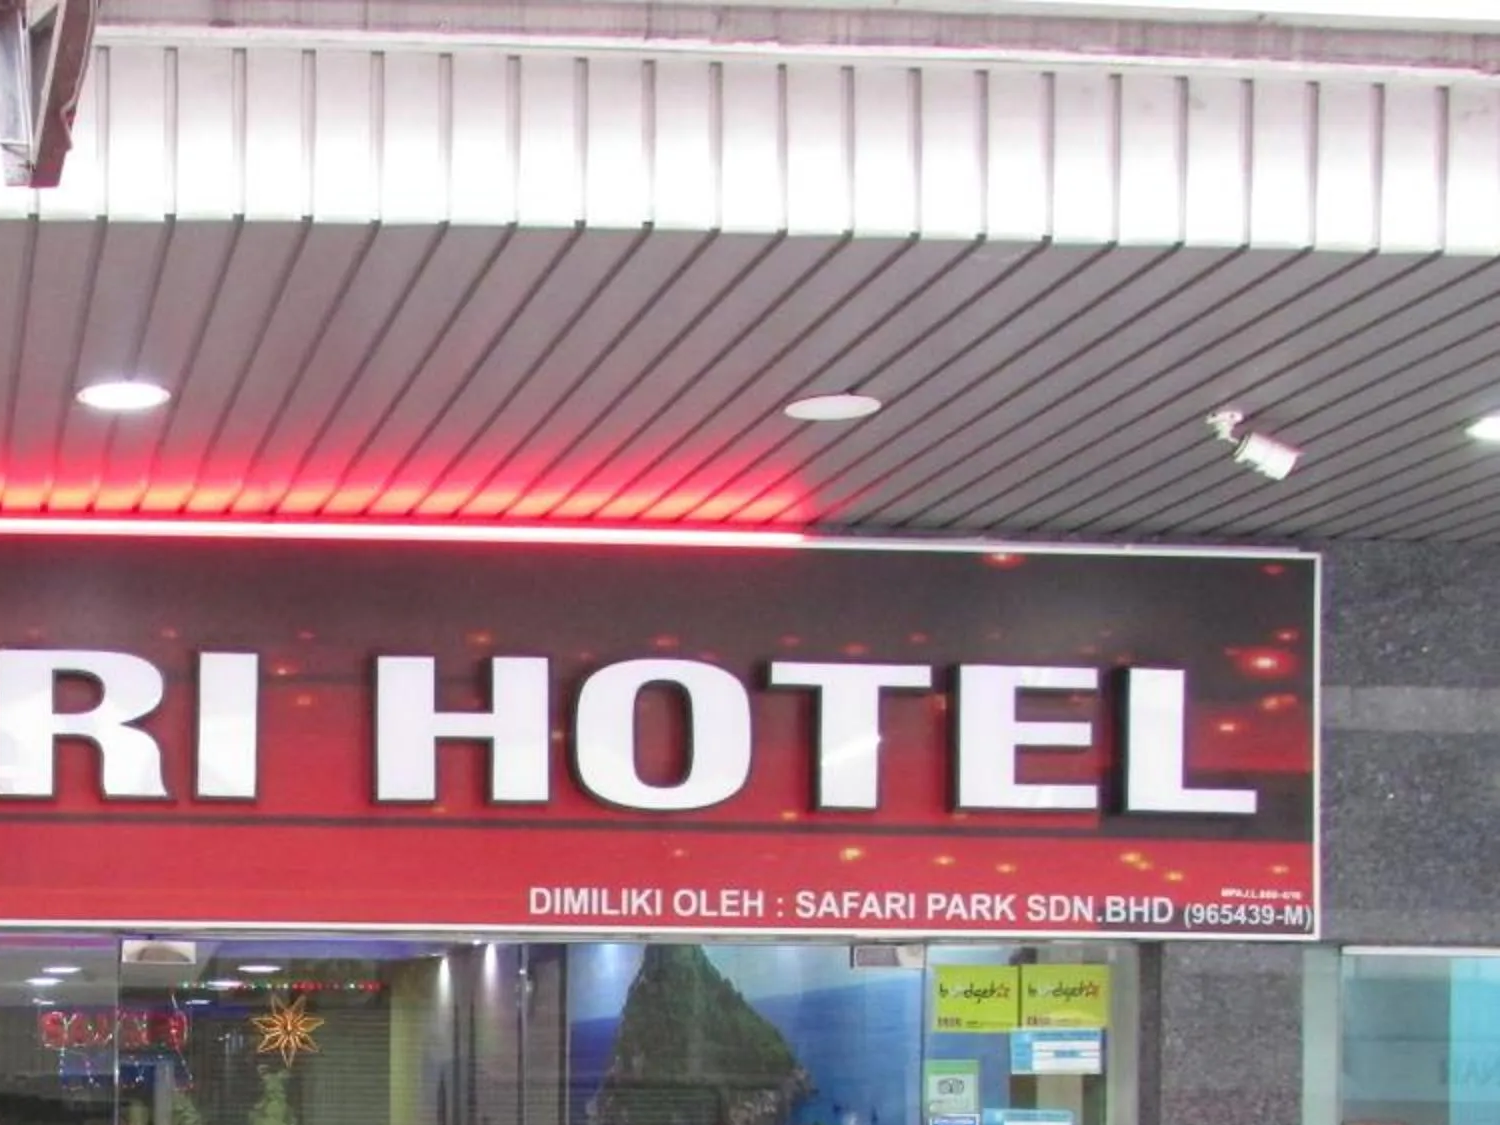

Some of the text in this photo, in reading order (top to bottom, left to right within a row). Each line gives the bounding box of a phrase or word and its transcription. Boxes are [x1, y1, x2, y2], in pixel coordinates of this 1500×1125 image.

[375, 655, 1258, 814] HOTEL
[528, 887, 662, 915] DIMILIKI
[673, 889, 764, 917] OLEH
[795, 891, 916, 920] SAFARI
[927, 893, 1017, 922] PARK
[1184, 902, 1313, 929] (965439-M)
